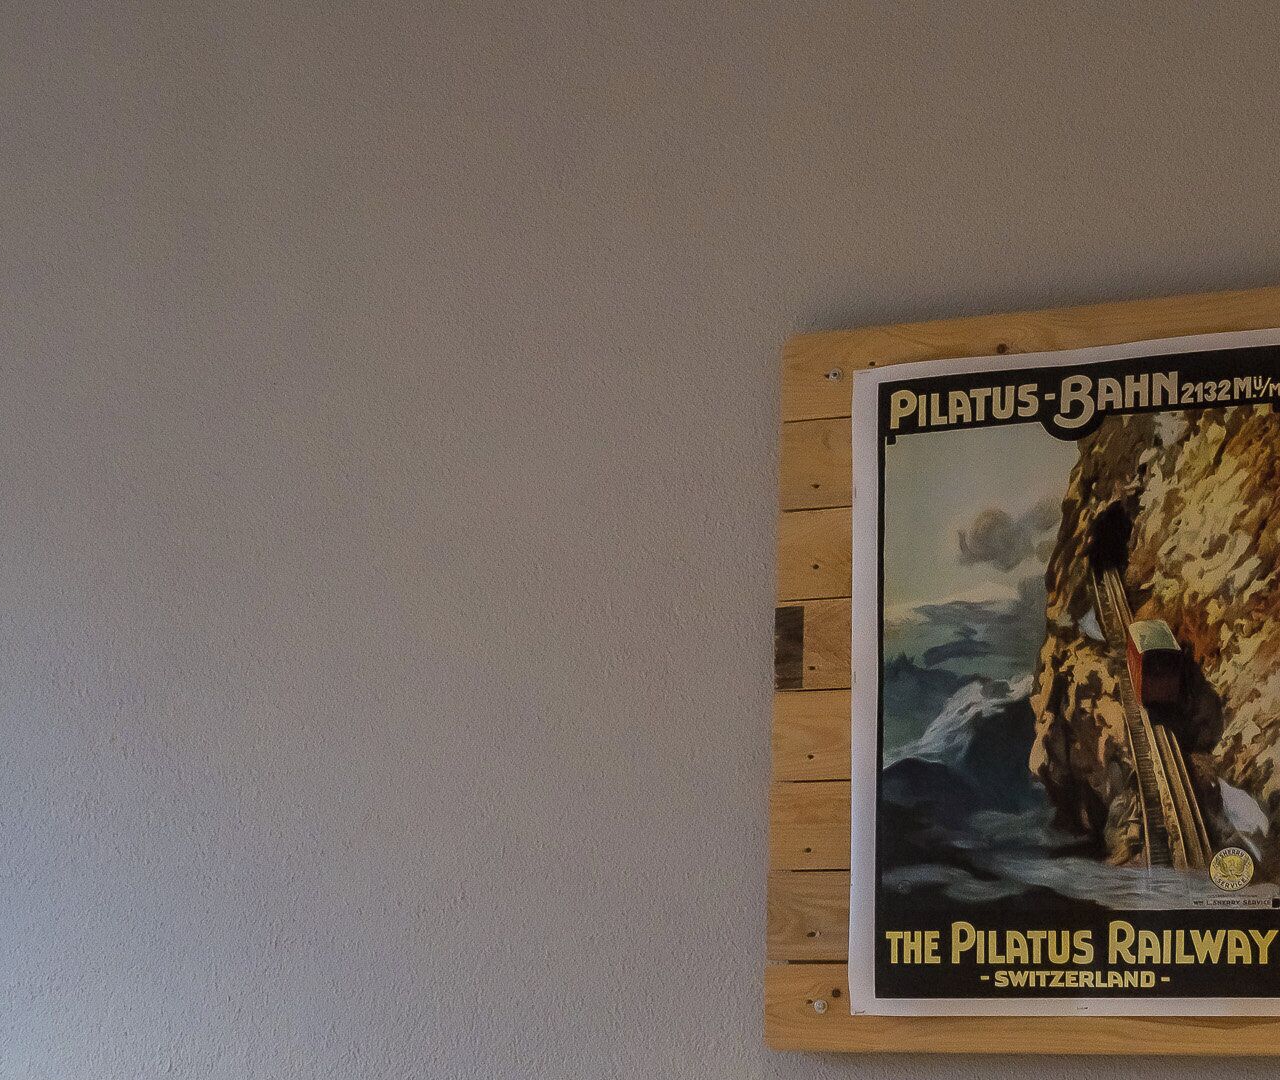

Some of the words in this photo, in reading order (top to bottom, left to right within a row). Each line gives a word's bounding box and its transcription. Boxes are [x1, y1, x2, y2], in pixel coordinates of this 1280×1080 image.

[1181, 379, 1231, 404] 2132
[886, 930, 941, 964] THE
[951, 921, 1094, 964] PILATUS
[1108, 920, 1279, 964] RAILWAY
